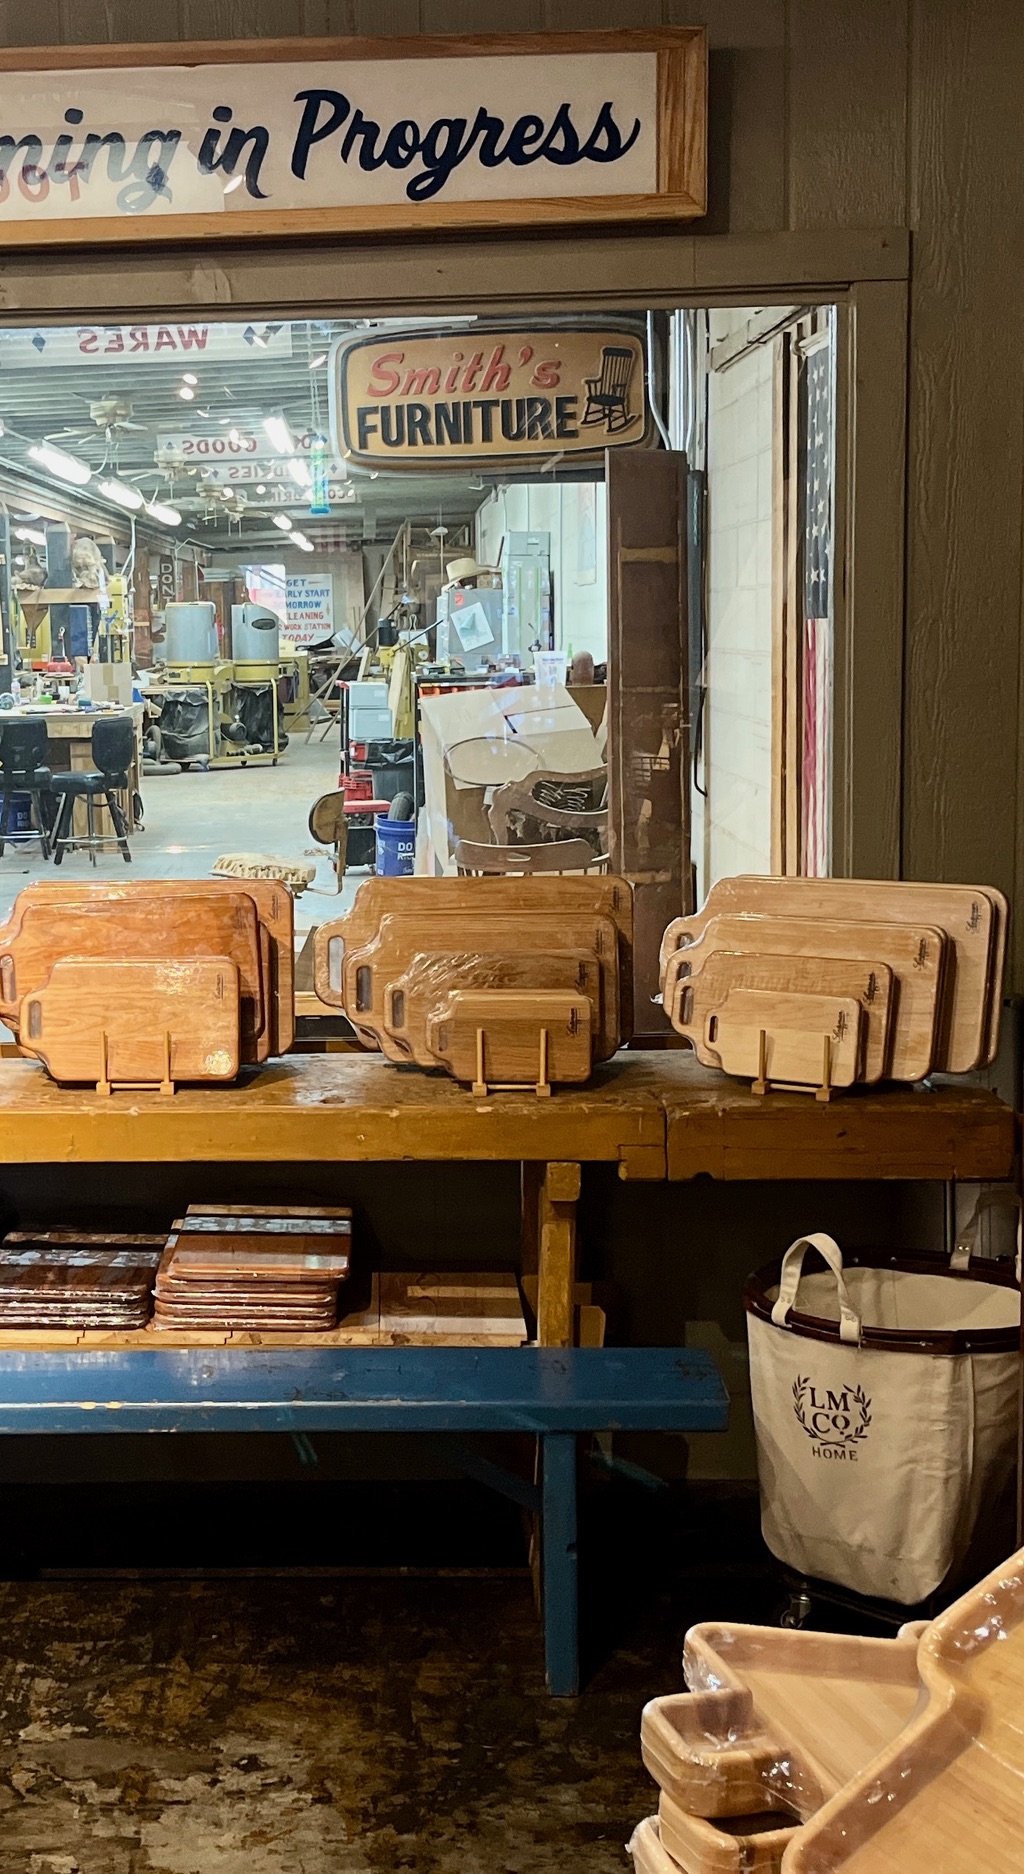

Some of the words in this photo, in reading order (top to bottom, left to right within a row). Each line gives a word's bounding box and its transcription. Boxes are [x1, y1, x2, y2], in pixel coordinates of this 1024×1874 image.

[198, 105, 273, 199] in
[293, 88, 642, 201] Progress
[367, 344, 562, 397] Smith's
[356, 396, 580, 450] FURNITURE
[286, 579, 307, 587] GET
[281, 590, 303, 598] RLY
[305, 589, 330, 598] START
[280, 600, 322, 609] MORROW
[286, 611, 324, 621] LEANING
[809, 1386, 851, 1412] LM
[812, 1446, 858, 1461] HOME
